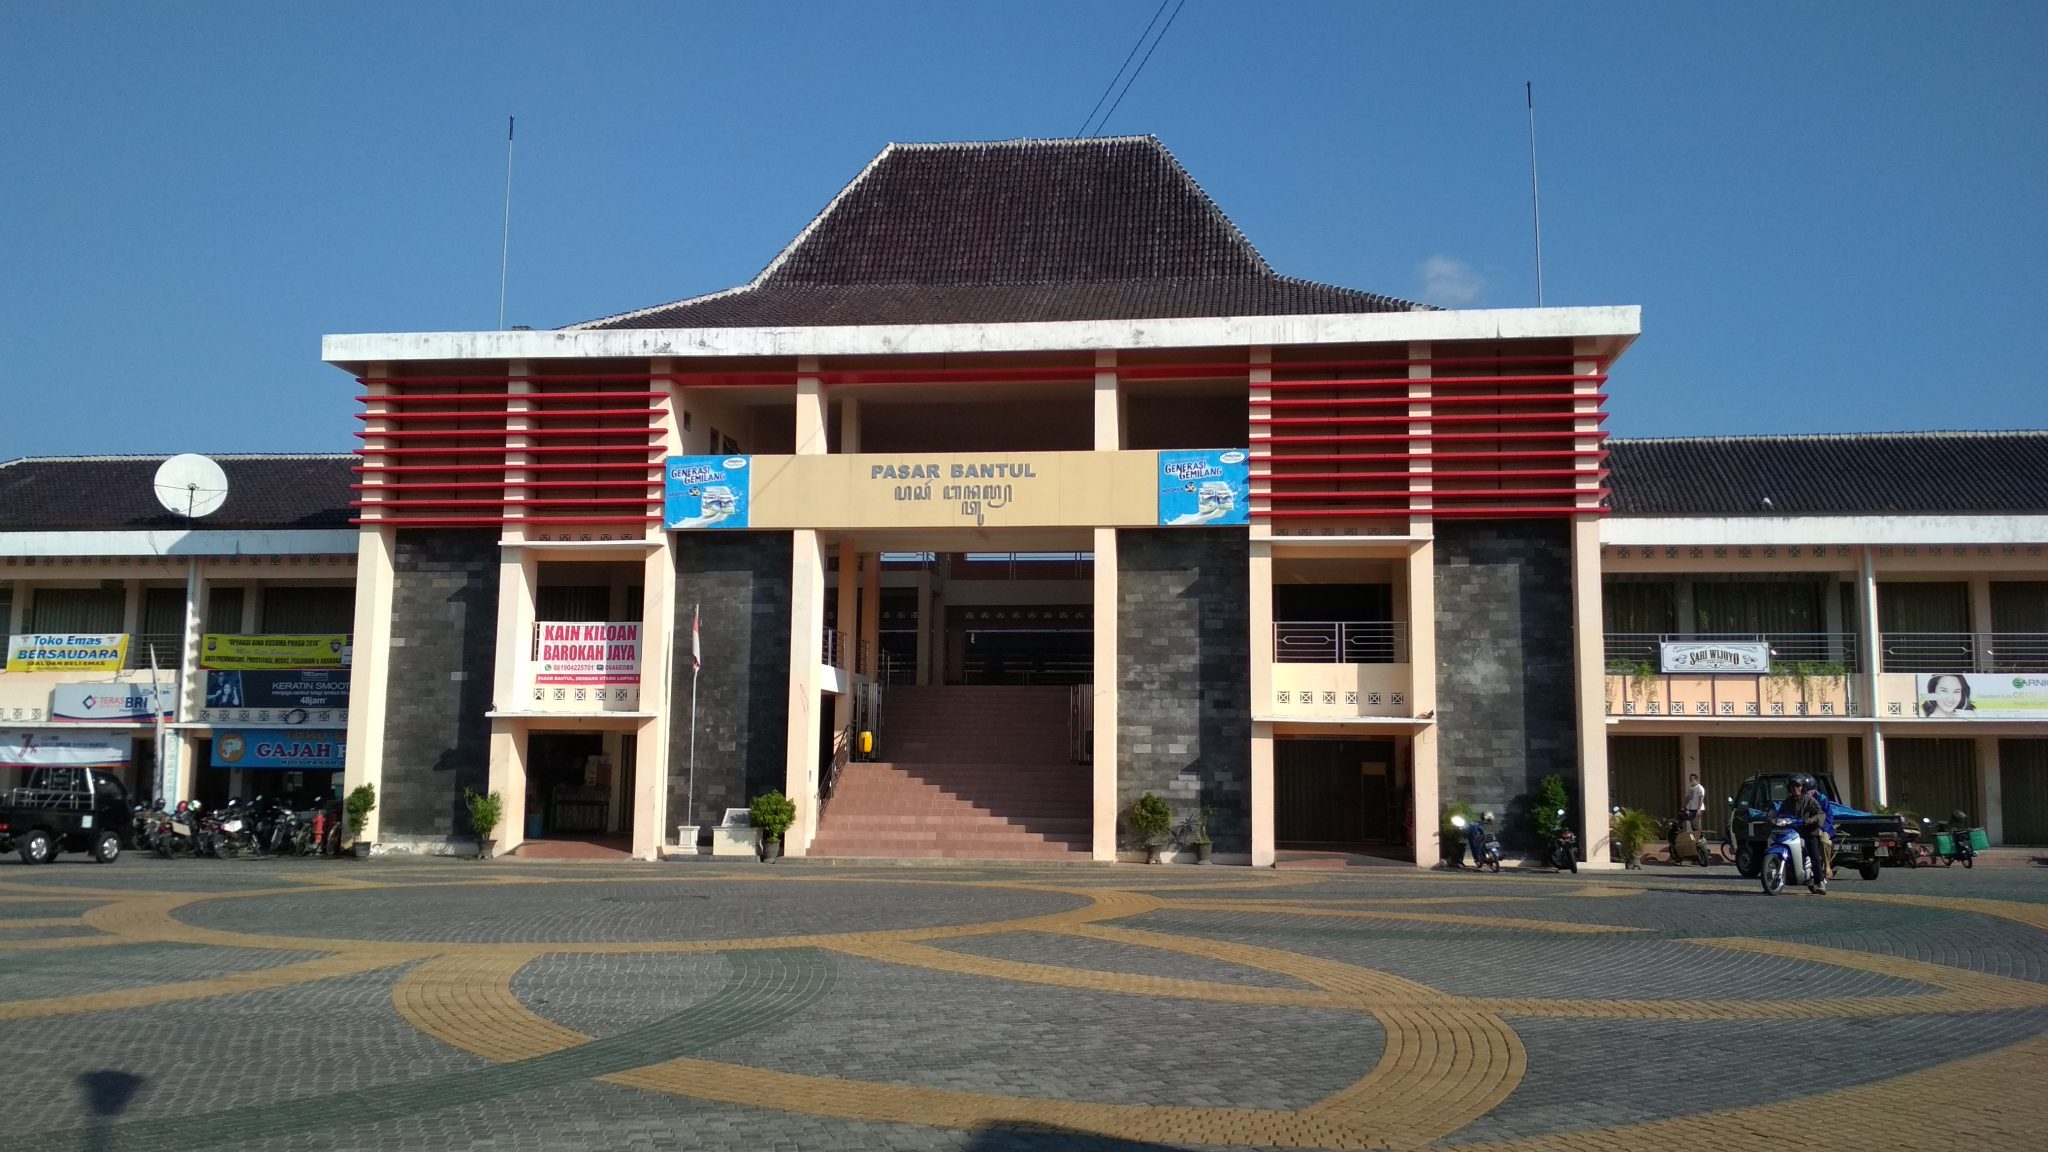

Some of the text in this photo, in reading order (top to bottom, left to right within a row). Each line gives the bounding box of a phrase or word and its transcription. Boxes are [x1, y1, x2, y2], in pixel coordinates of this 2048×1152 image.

[671, 466, 710, 478] GENERASI
[871, 463, 1036, 479] PASAR BANTUL
[1165, 461, 1206, 473] GENERASI
[684, 472, 725, 484] GEMILANG
[1179, 468, 1222, 480] GEMILANG
[545, 625, 637, 641] KAIN KILOAN
[34, 636, 64, 645] Toko
[67, 636, 102, 645] Emas
[18, 649, 118, 660] BERSAUDARA
[543, 645, 636, 661] BAROKAH JAYA
[1690, 650, 1707, 665] SARI
[272, 682, 313, 690] KERATIN
[100, 696, 148, 708] TERAS BRI
[256, 742, 332, 758] GAJAH
